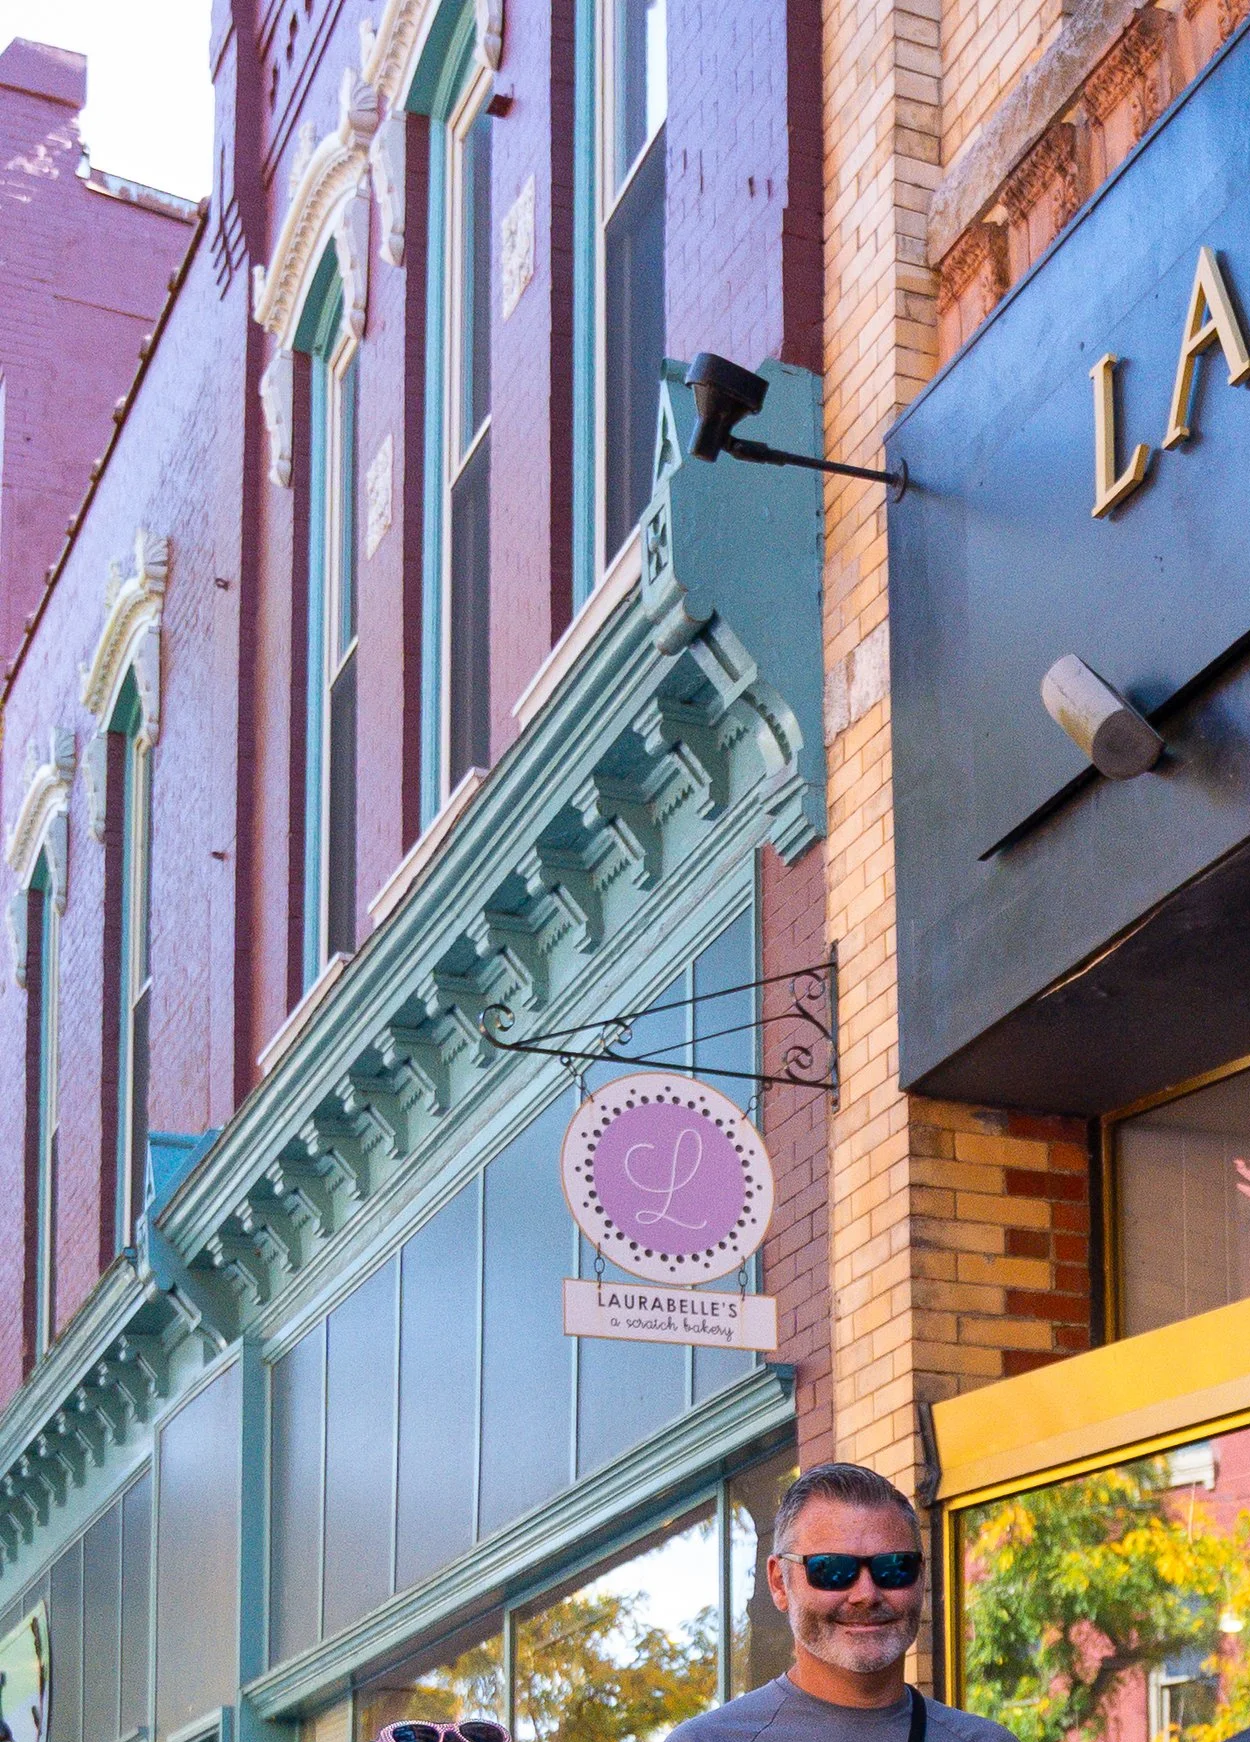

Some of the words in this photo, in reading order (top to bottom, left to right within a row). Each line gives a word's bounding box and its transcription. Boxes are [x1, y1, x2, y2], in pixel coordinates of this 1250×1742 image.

[598, 1291, 738, 1318] LAURABELLE'S
[610, 1317, 621, 1328] a
[683, 1318, 734, 1342] bakery
